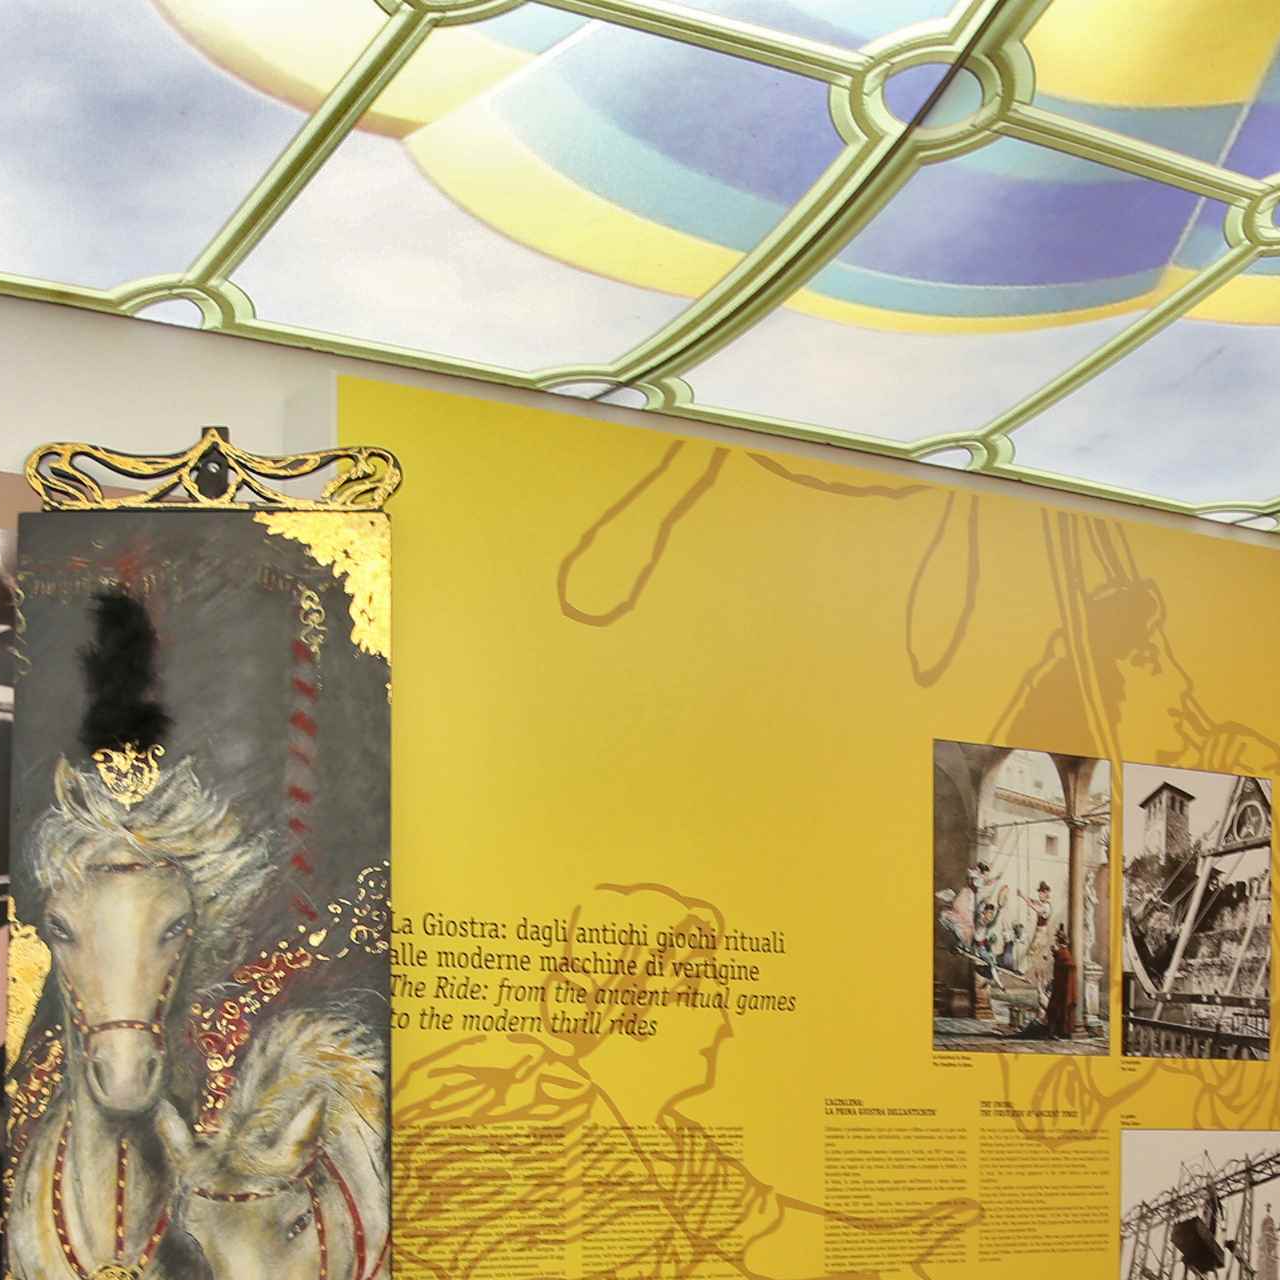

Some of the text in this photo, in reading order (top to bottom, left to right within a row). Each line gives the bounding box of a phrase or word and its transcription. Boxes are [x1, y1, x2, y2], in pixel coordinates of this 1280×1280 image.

[423, 912, 507, 940] Giostra:
[517, 917, 569, 948] dagli
[576, 920, 648, 947] antichi
[656, 925, 718, 954] giochi
[724, 928, 786, 955] rituali
[391, 943, 761, 985] alle moderne macchine di vertigine
[391, 974, 797, 1015] The Ride: from the ancient ritual games
[419, 1006, 454, 1032] the
[462, 1008, 544, 1034] modern
[551, 1010, 603, 1036] thrill
[608, 1012, 658, 1037] rides
